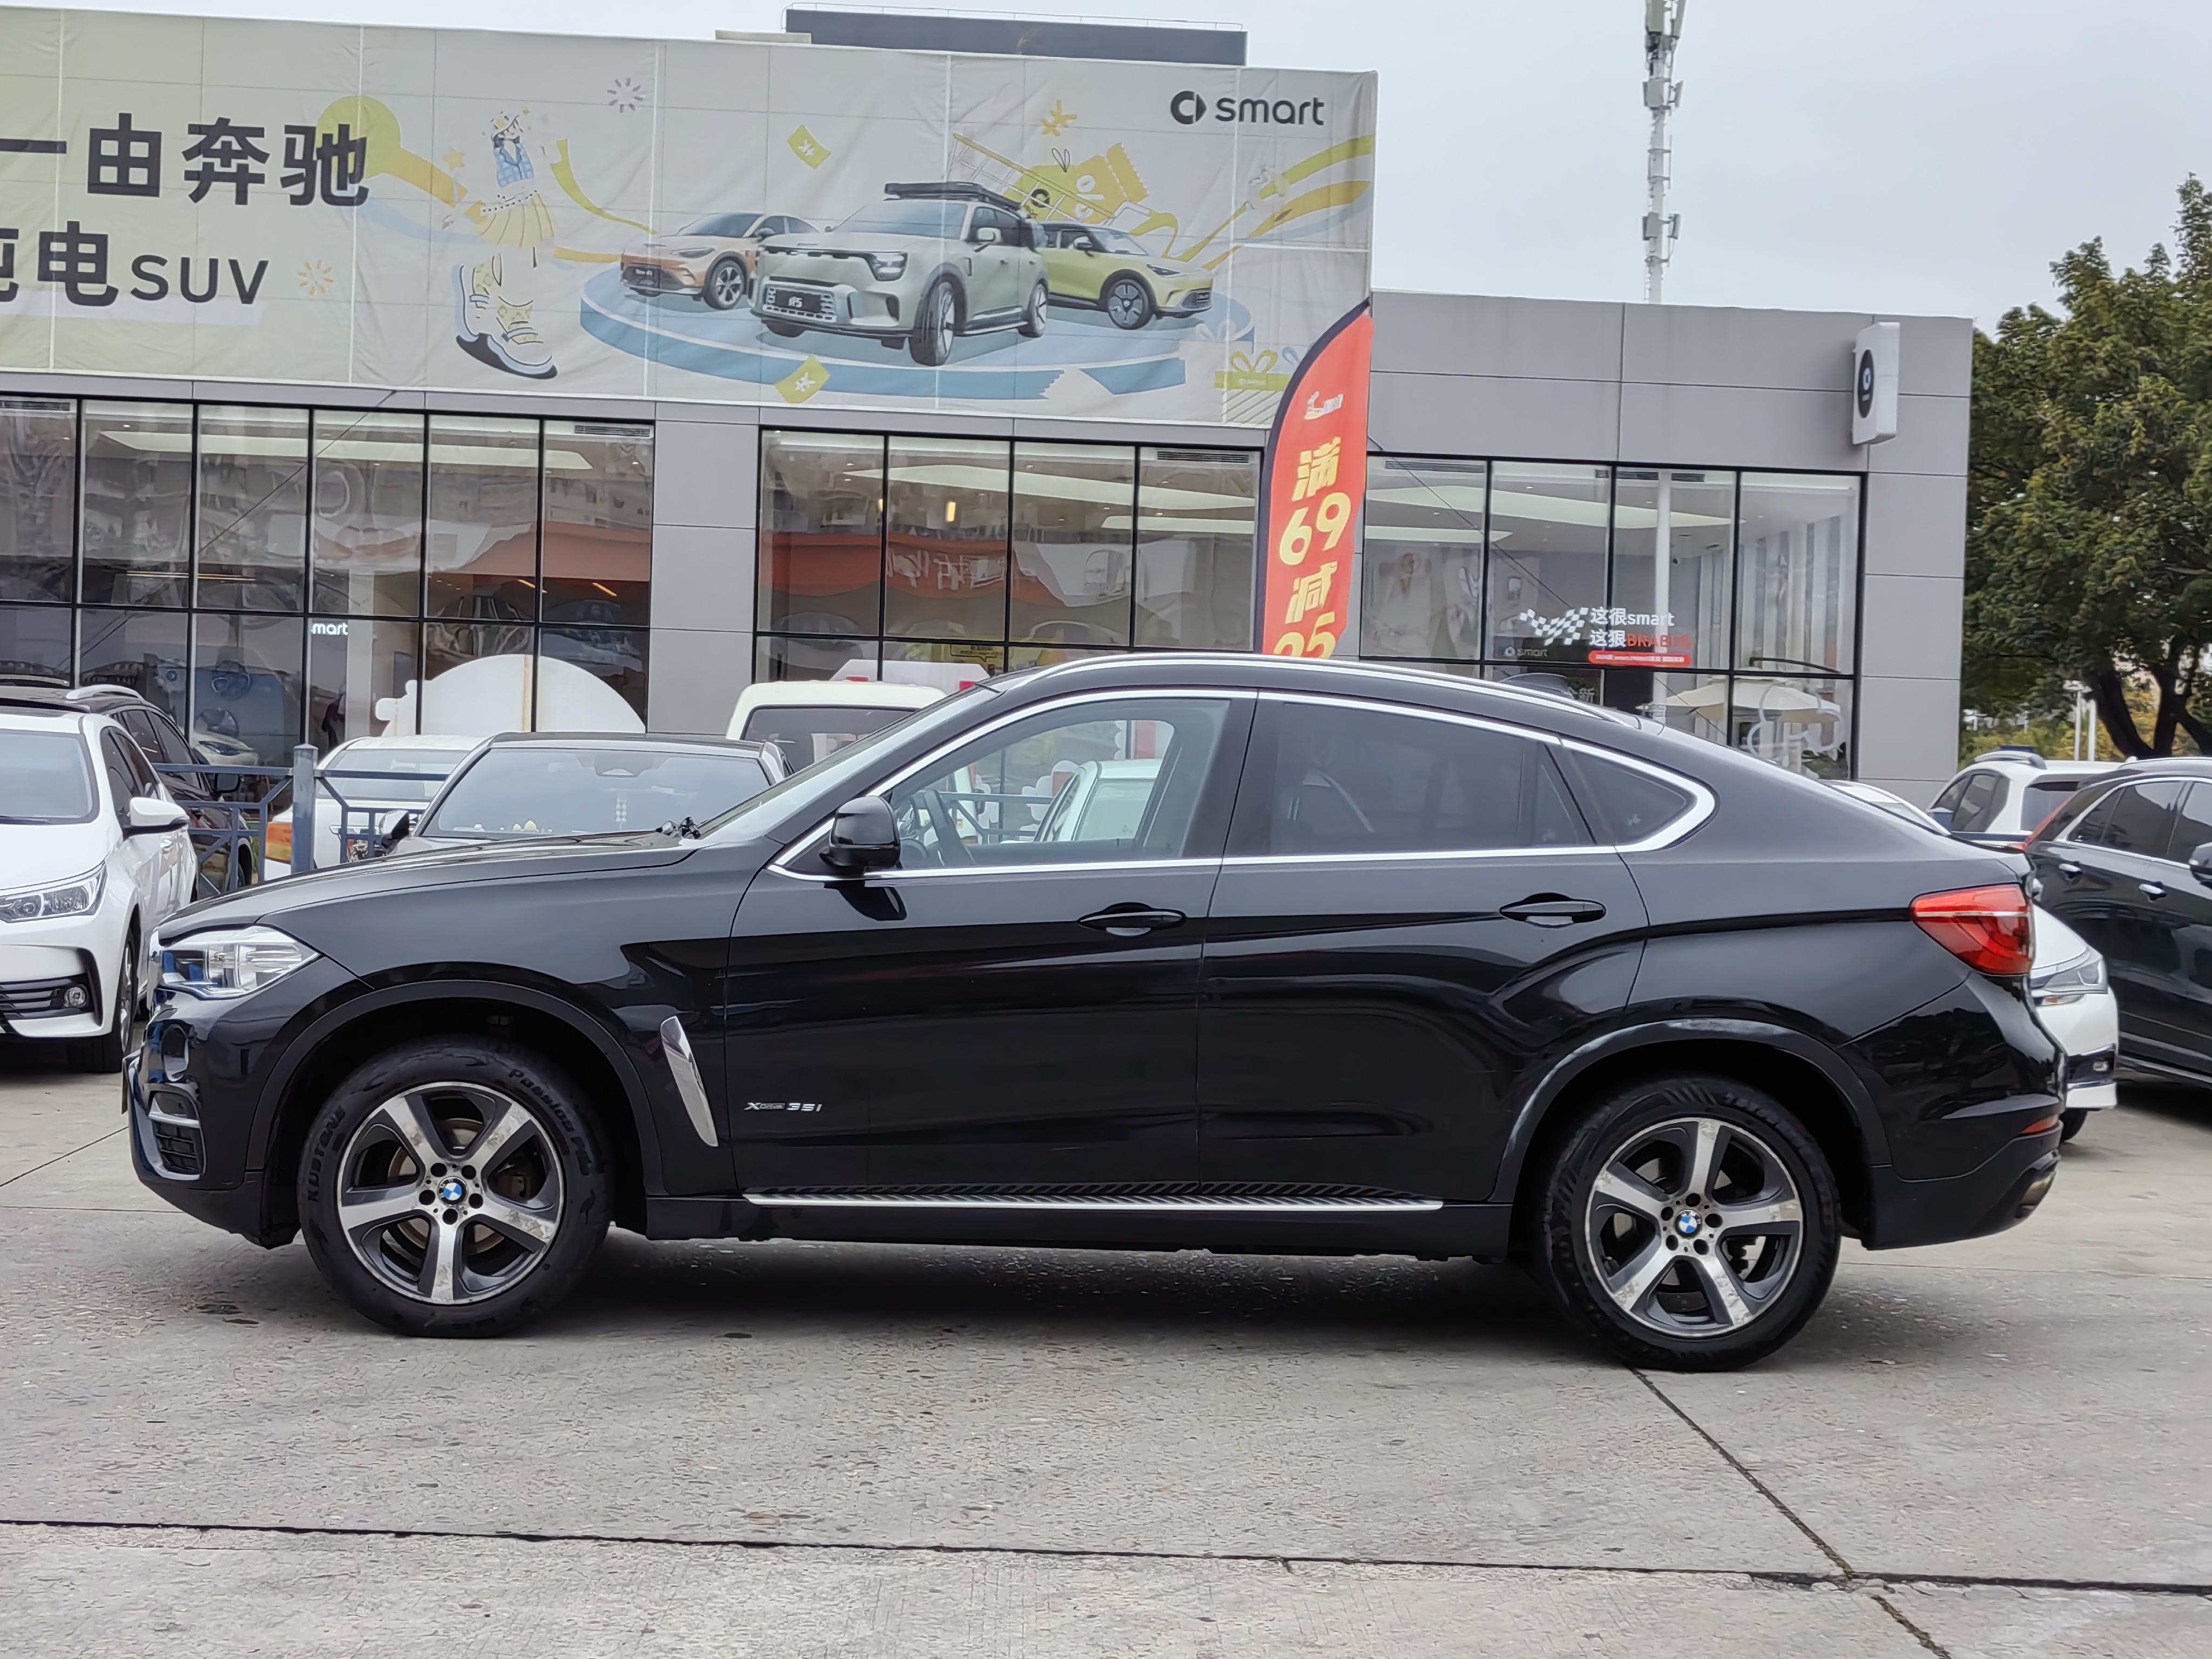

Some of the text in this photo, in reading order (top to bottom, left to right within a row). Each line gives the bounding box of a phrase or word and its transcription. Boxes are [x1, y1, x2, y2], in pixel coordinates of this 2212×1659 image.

[1215, 97, 1325, 125] smart
[1590, 606, 1675, 626] 这很smart
[311, 623, 348, 636] mart
